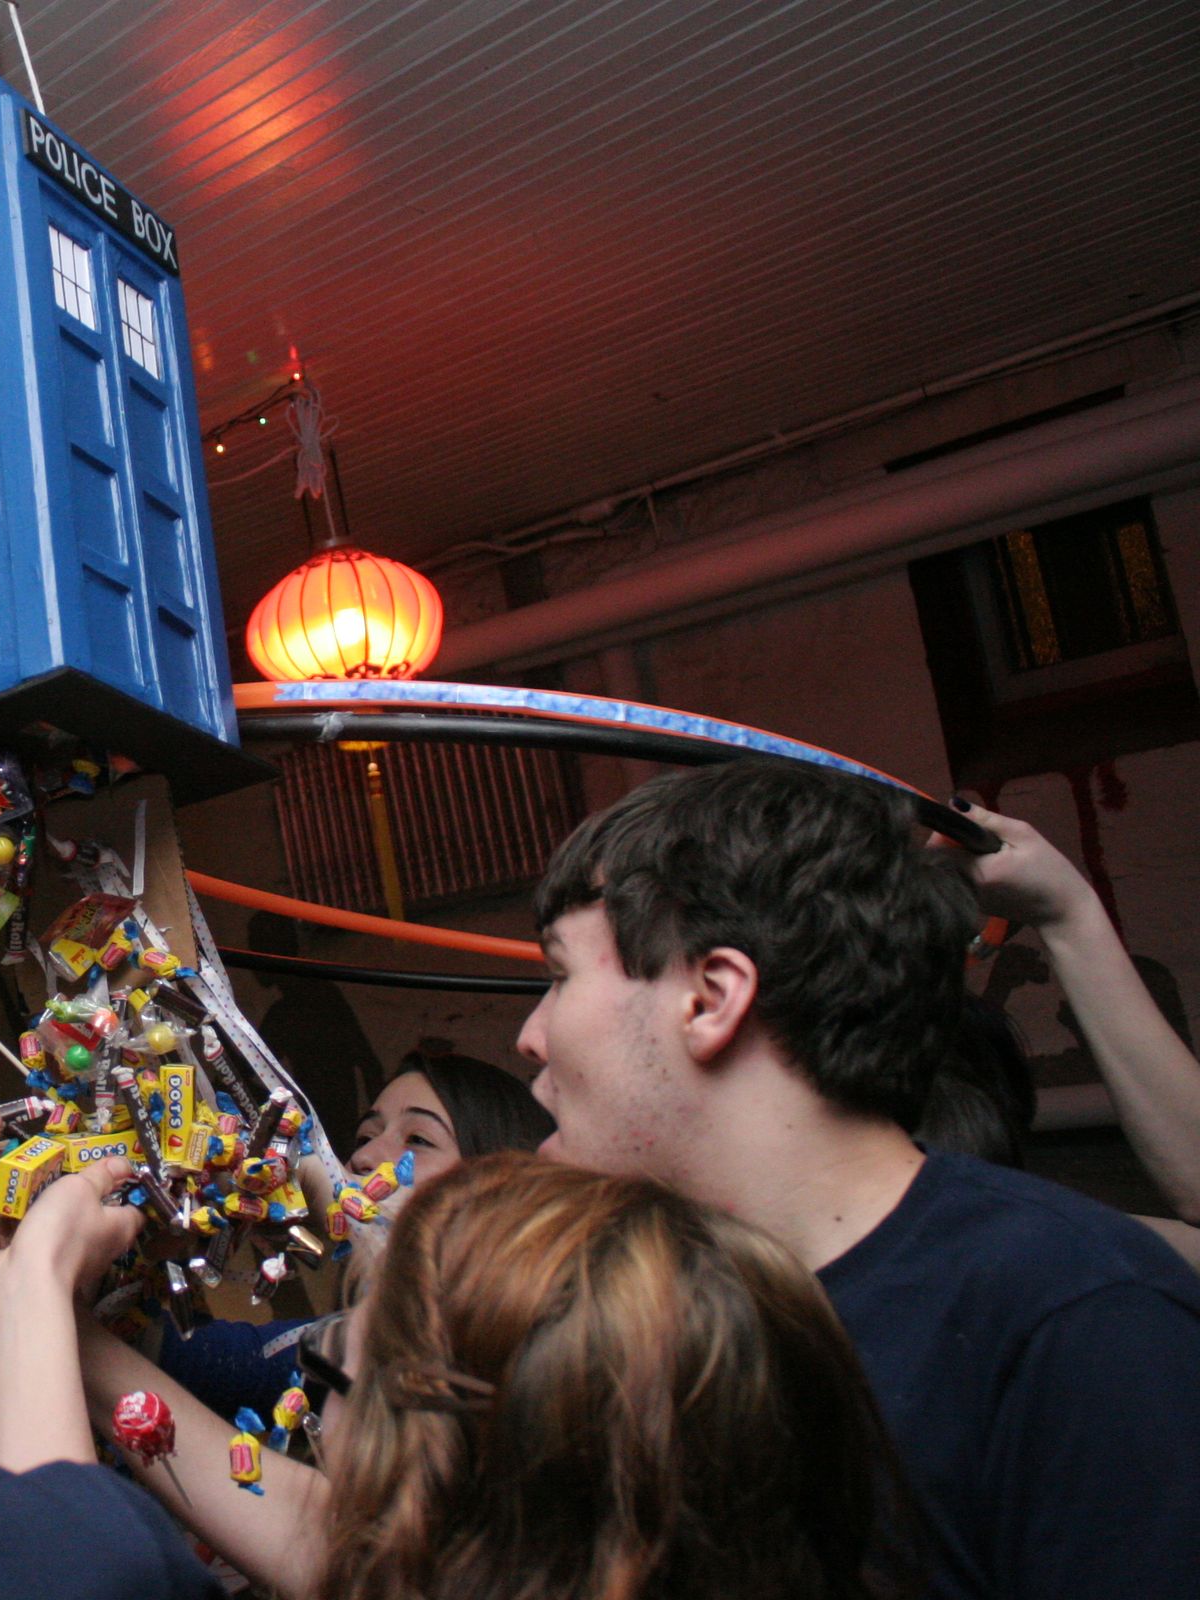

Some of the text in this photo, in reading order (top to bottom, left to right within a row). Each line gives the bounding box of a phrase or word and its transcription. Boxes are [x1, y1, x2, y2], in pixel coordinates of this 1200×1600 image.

[30, 116, 178, 269] POLICE BOX
[211, 1055, 237, 1086] Roll
[168, 1074, 182, 1129] DOTS
[79, 1142, 127, 1162] DOTS
[6, 1169, 19, 1204] DOTS
